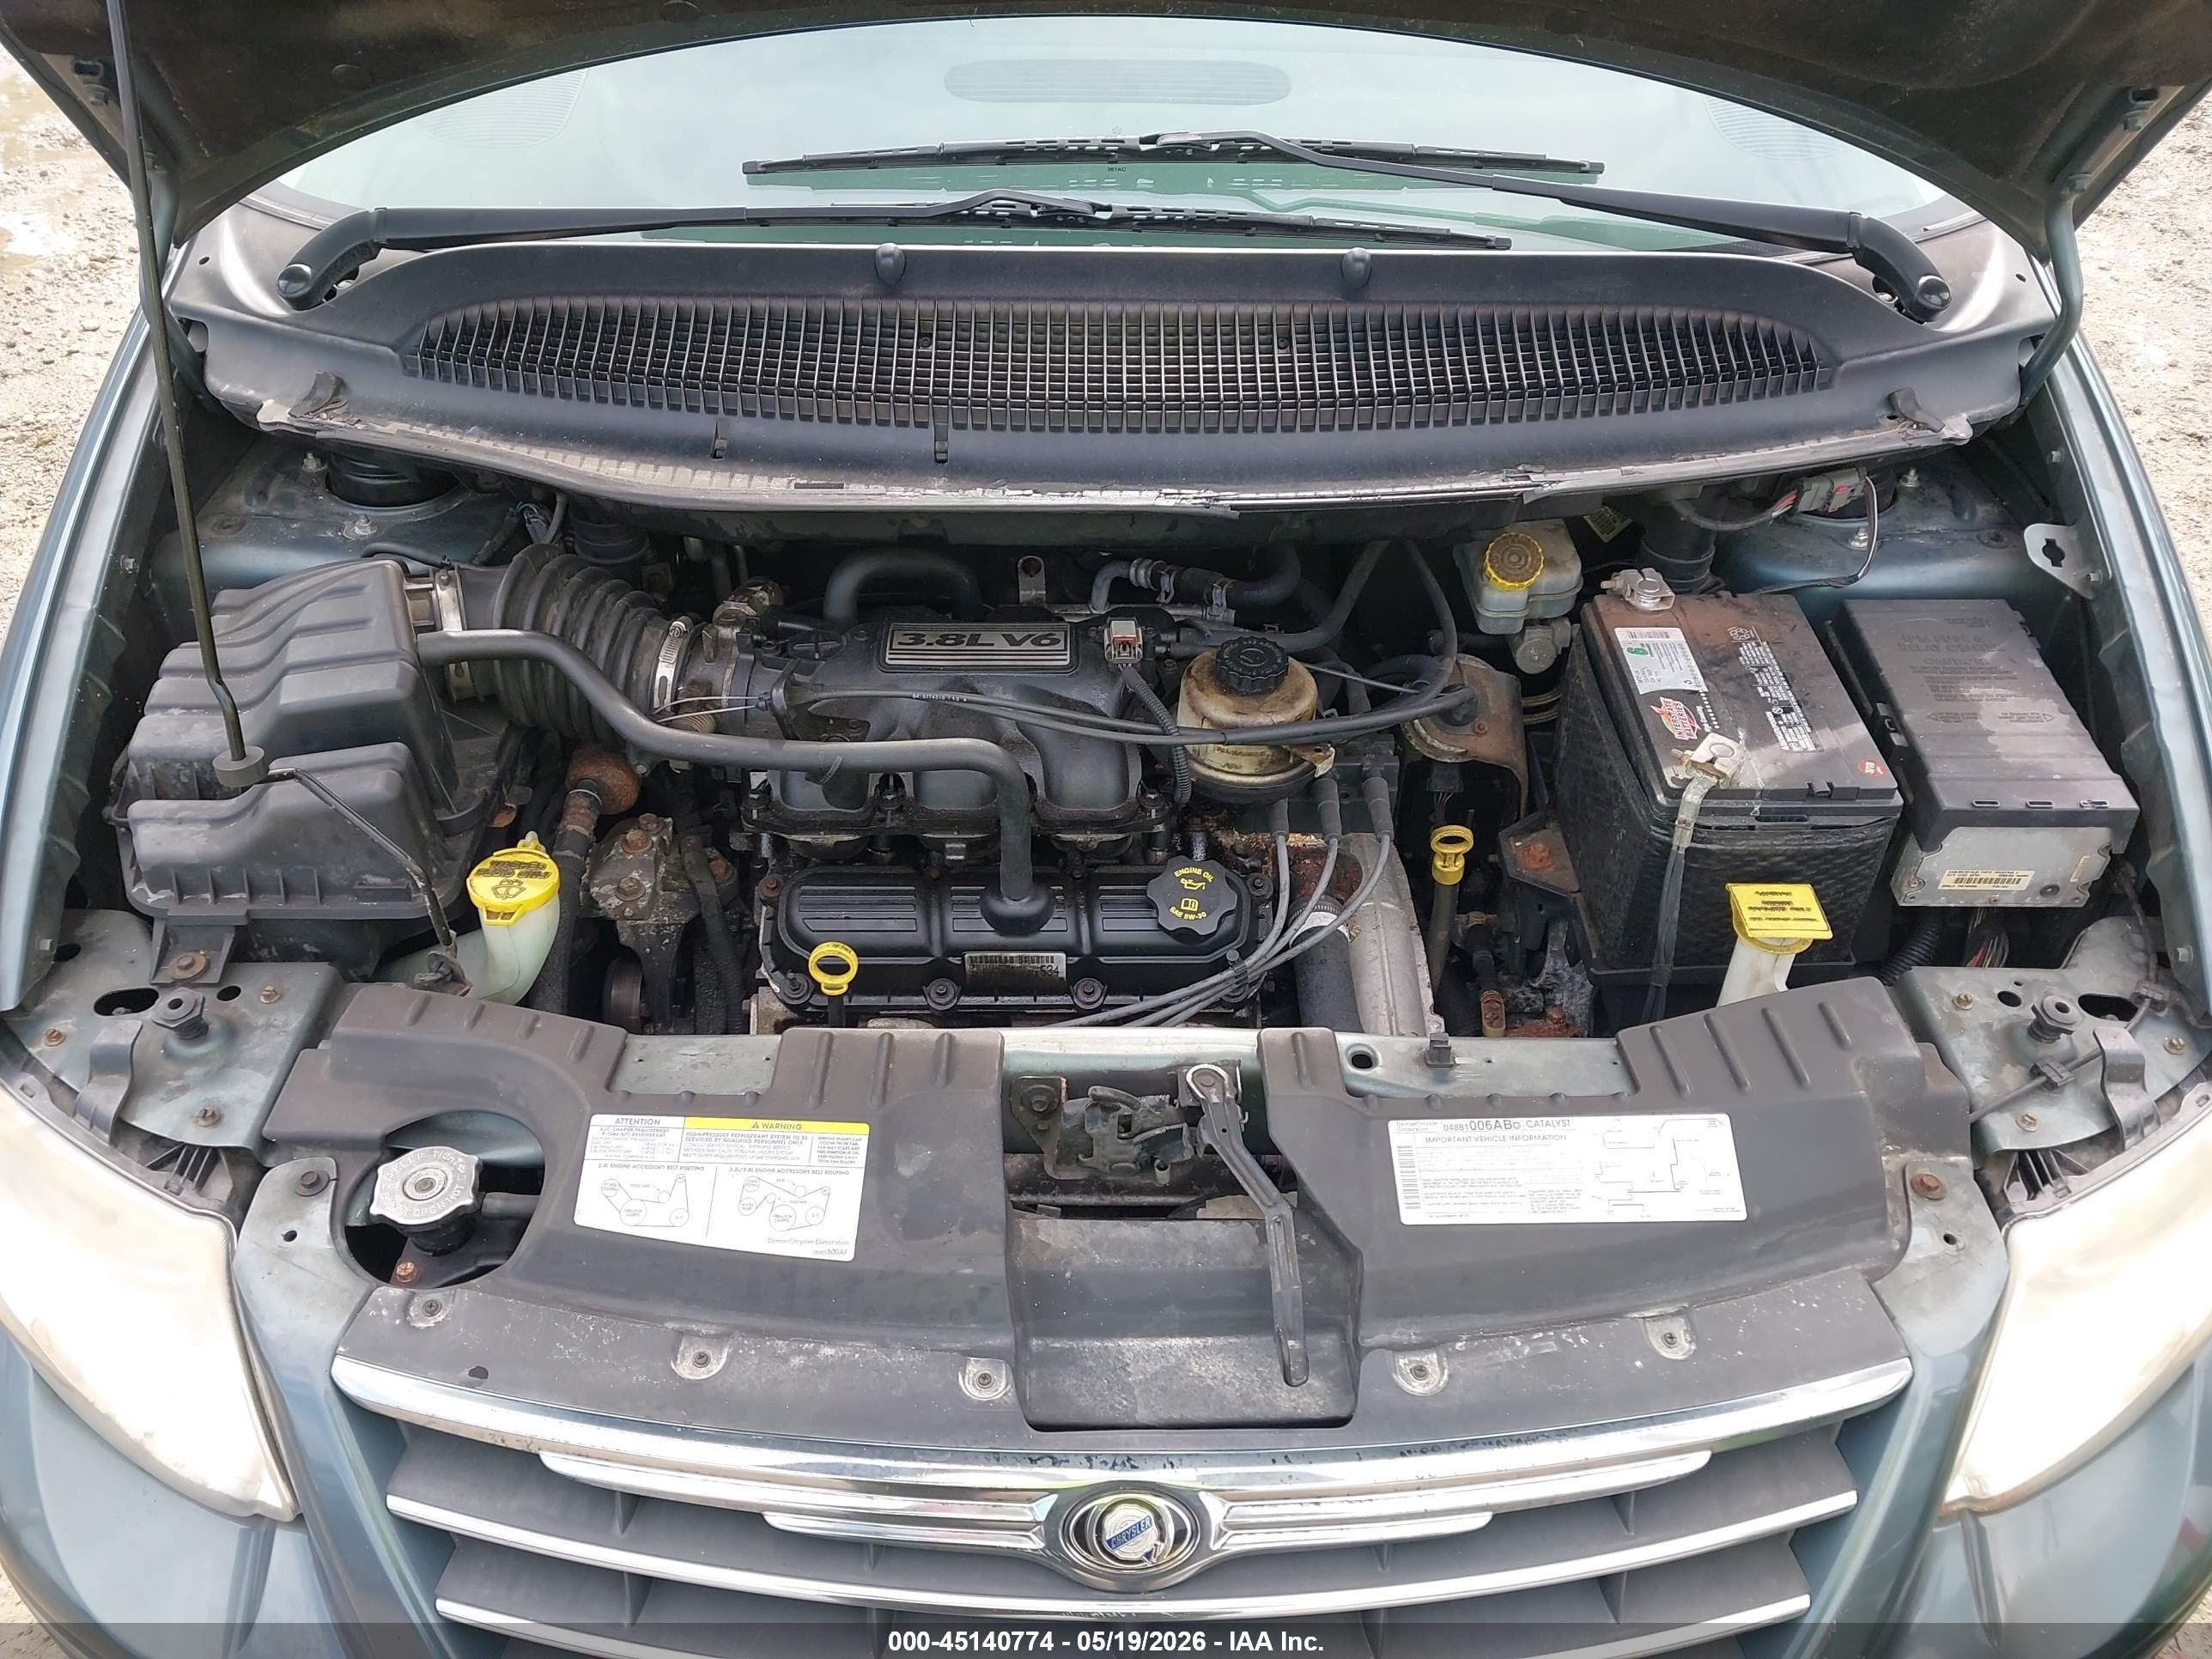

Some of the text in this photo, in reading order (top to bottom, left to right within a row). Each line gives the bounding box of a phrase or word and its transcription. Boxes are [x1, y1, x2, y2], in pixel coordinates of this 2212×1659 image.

[897, 632, 1061, 646] 3.8L V6
[1662, 699, 1683, 738] INTERSTATE
[1673, 702, 1693, 737] BATTERIES
[1174, 867, 1214, 883] ENGINE OIL
[1170, 906, 1207, 921] SAE 5W-30
[1525, 1119, 1571, 1128] CATALYST
[1509, 1133, 1567, 1142] INFORMATION
[1111, 1516, 1153, 1549] CHRYSLER
